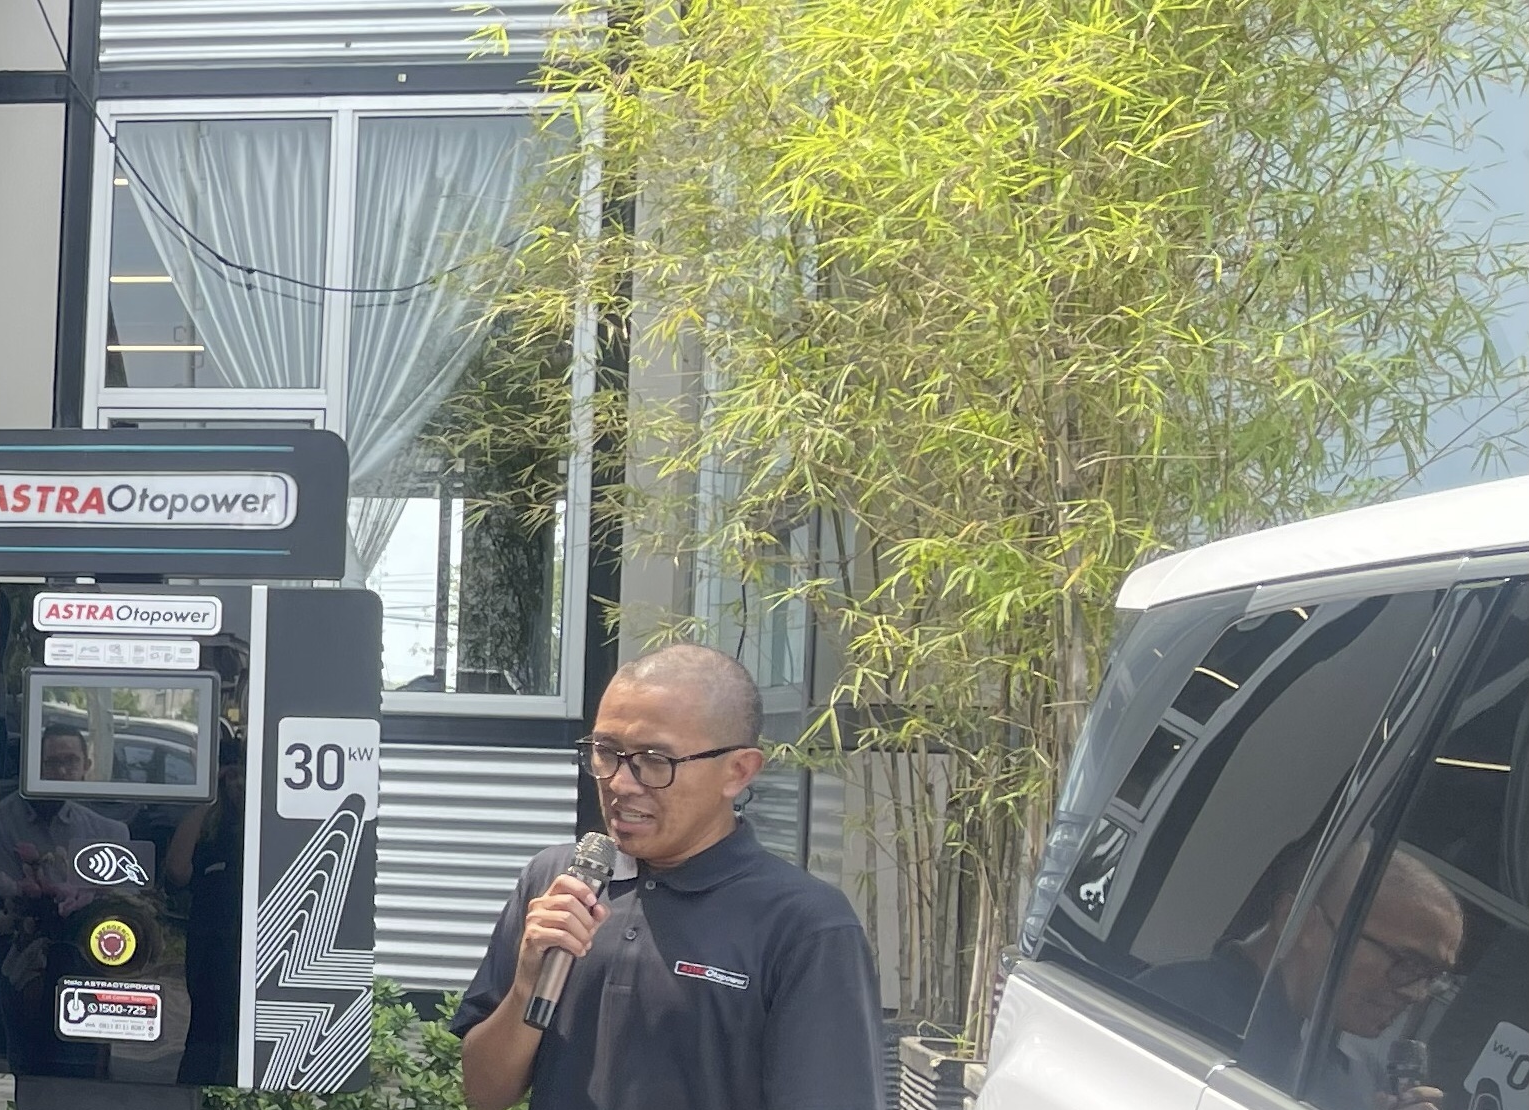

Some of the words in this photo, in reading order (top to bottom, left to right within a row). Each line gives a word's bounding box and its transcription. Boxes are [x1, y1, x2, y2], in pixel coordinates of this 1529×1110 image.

[45, 603, 210, 626] ASTRAOtopower
[284, 742, 345, 791] 30
[348, 746, 374, 761] kW
[99, 1003, 146, 1015] 1500-725
